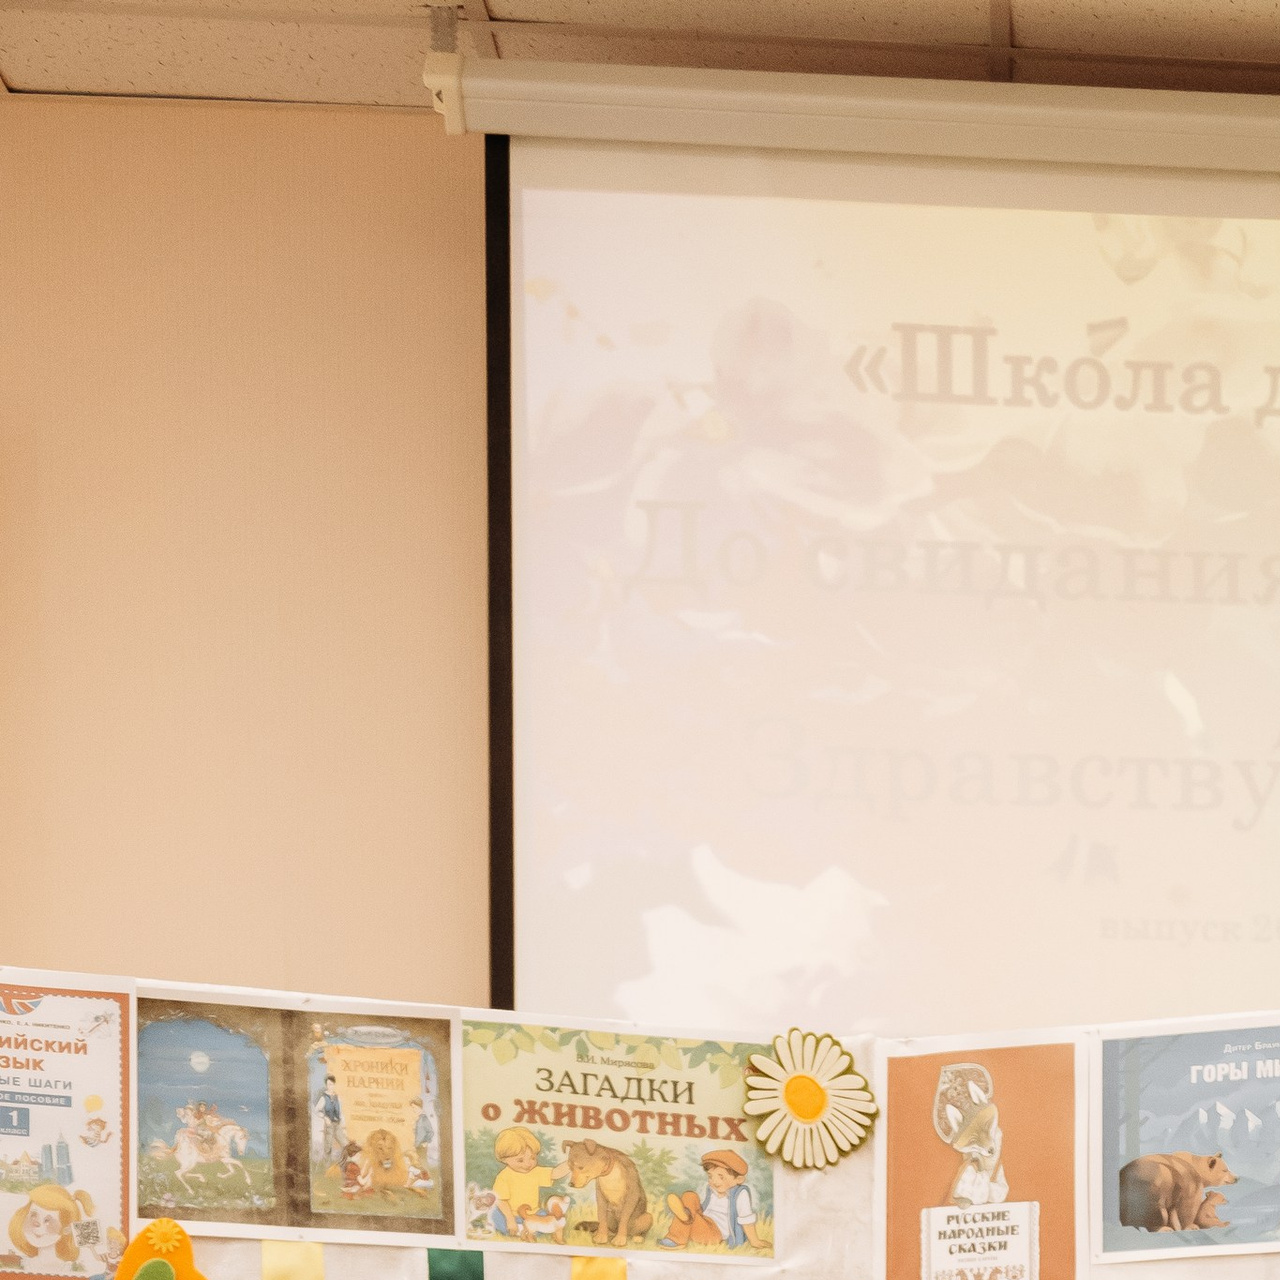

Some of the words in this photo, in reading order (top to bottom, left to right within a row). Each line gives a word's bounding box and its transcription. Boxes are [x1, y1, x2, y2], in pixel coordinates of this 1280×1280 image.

[1190, 1061, 1249, 1084] ГОРЫ
[28, 1077, 72, 1091] ШАГИ
[535, 1067, 695, 1105] ЗАГАДКИ
[15, 1094, 67, 1106] ПОСОБИЕ
[8, 1110, 19, 1127] 1
[513, 1098, 749, 1142] ЖИВОТНЫХ
[946, 1210, 1010, 1226] РУССКИЕ
[938, 1224, 1020, 1241] НАРОДНЫЕ
[948, 1240, 1008, 1256] СКАЗКИ
